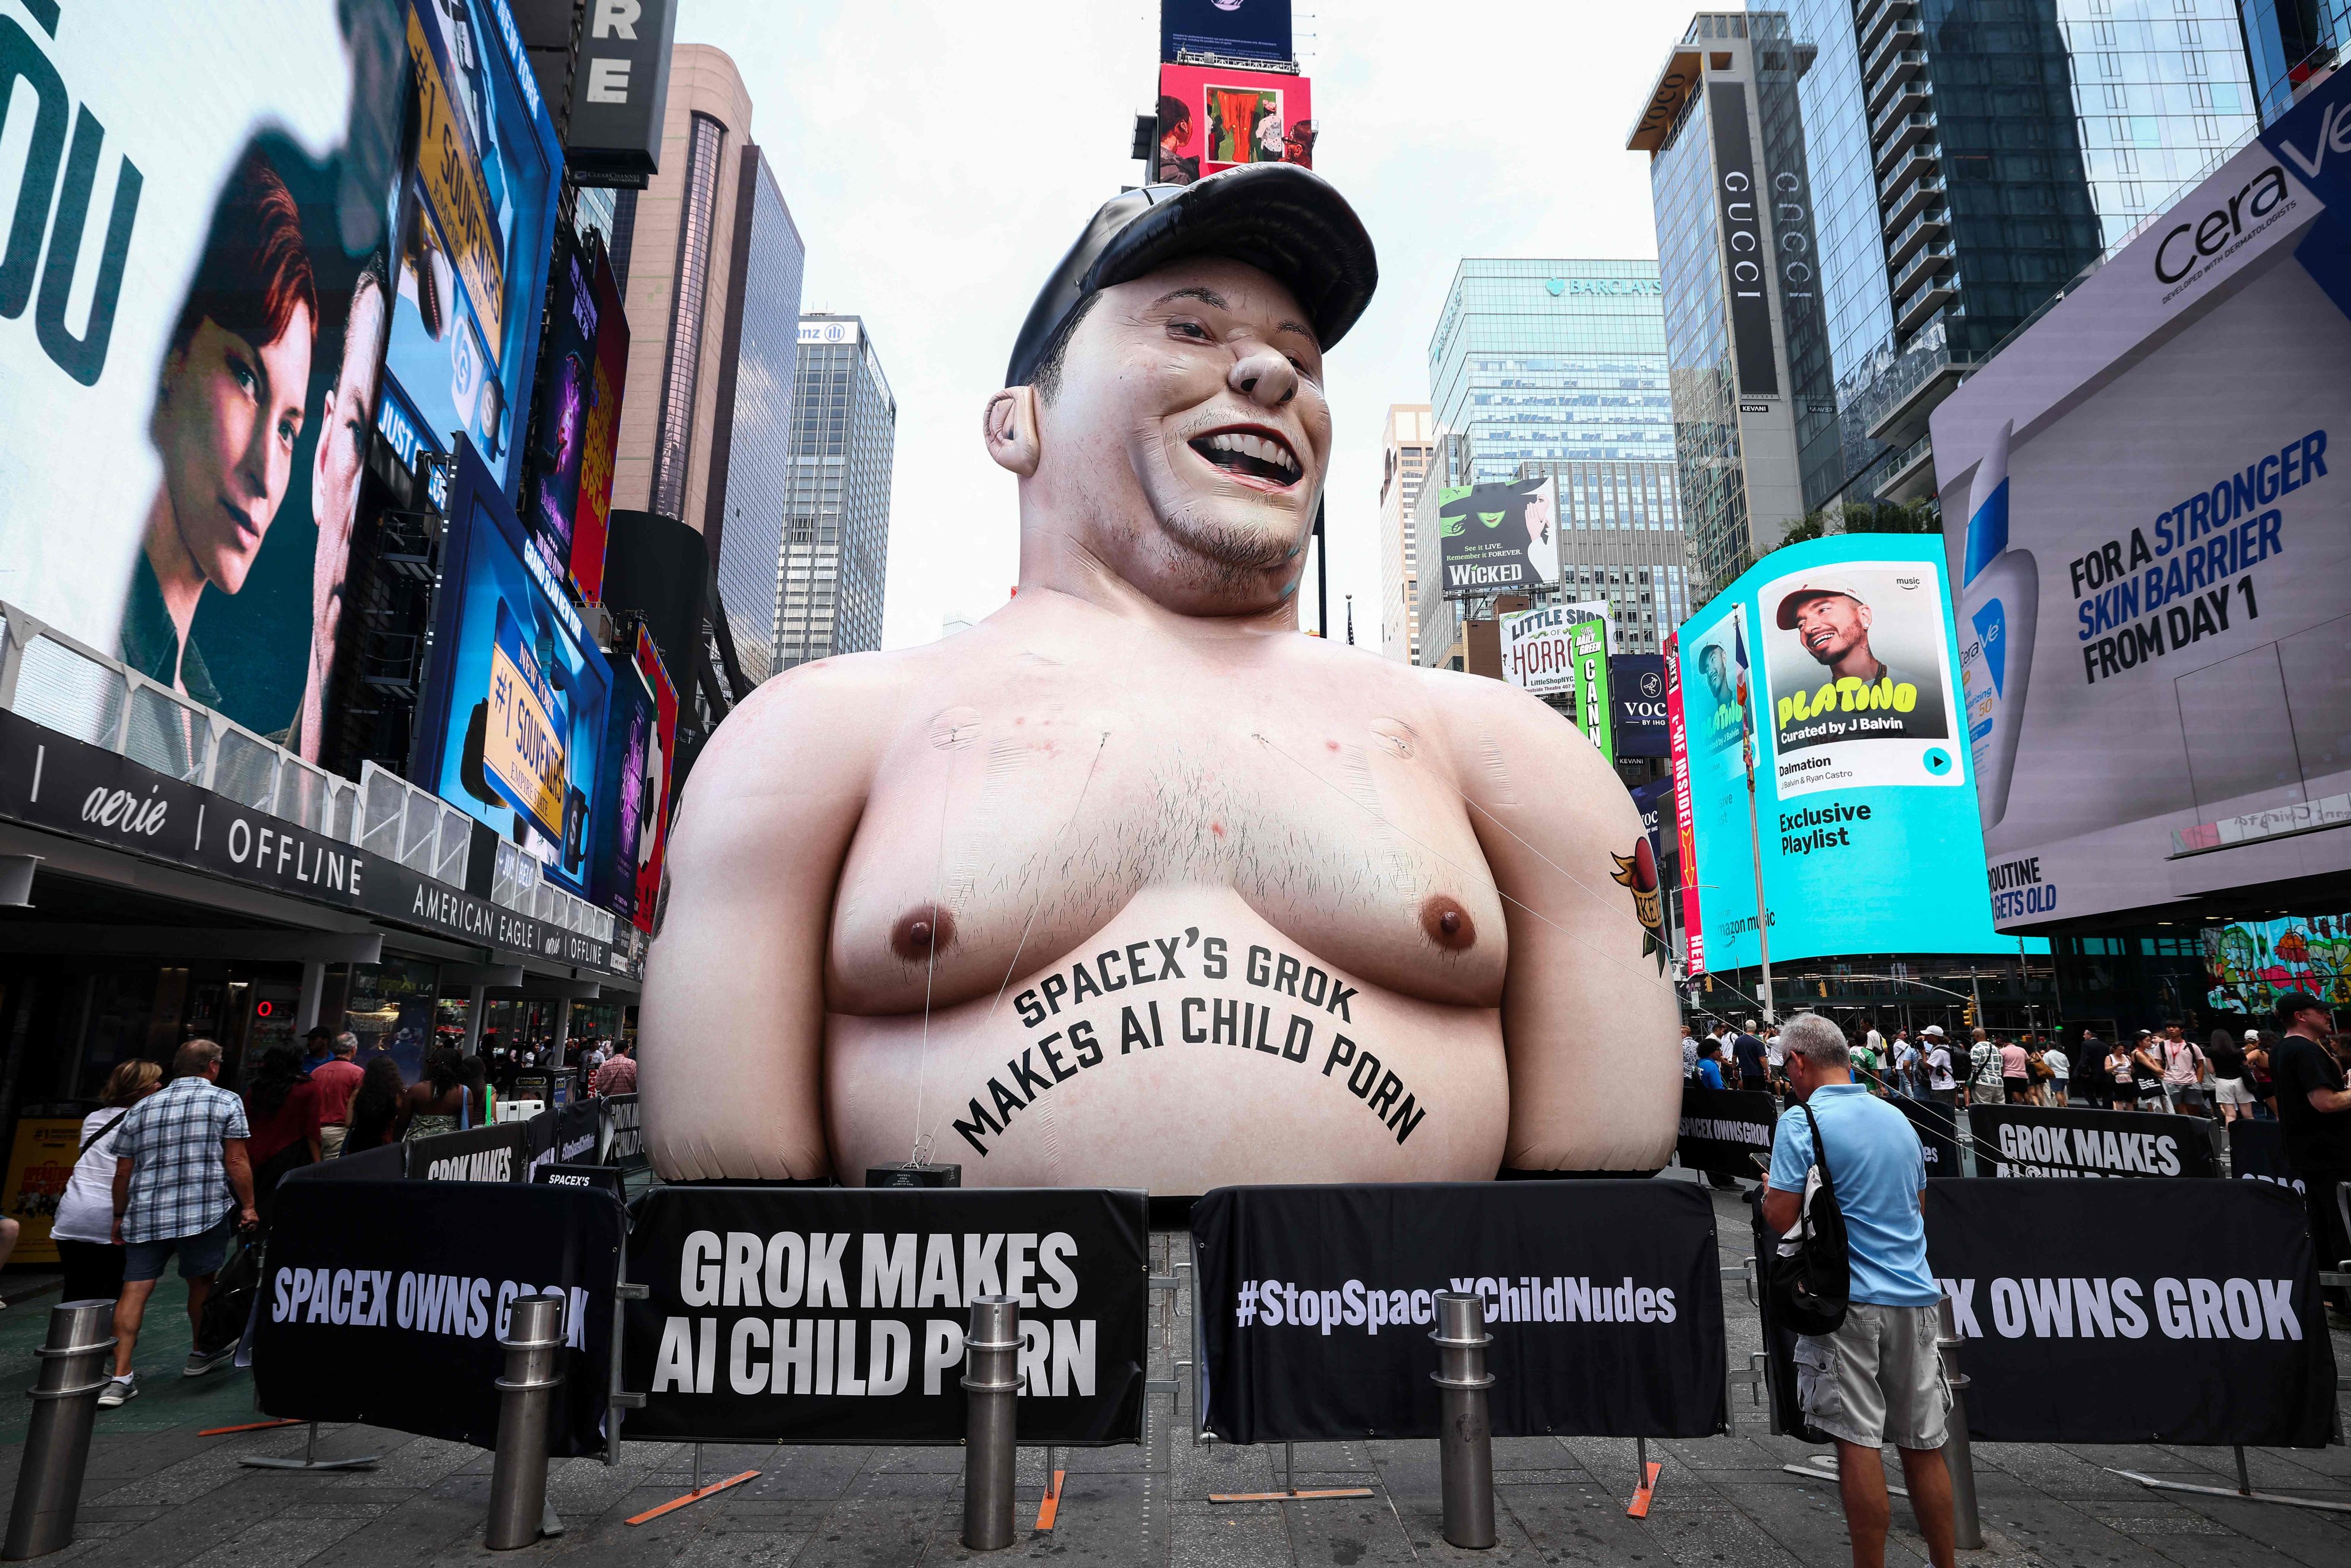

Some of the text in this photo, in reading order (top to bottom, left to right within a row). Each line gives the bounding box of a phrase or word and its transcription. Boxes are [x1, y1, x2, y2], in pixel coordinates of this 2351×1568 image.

[440, 123, 501, 324] SOUVENIRS
[1724, 171, 1761, 298] GUCCI
[2162, 200, 2297, 305] DEVELOPED WITH DERMATOLOGISTS
[1570, 279, 1662, 295] BARCLAYS
[378, 401, 414, 463] JUST
[2070, 429, 2329, 599] FOR A STRONGER
[1446, 553, 1480, 561] Remember
[1488, 549, 1522, 557] FOREVER.
[1896, 577, 1920, 585] music
[2078, 509, 2283, 641] SKIN BARRIER
[524, 539, 546, 585] GRAND
[544, 569, 559, 608] SLAM
[558, 591, 571, 624] NEW
[569, 608, 583, 643] YORK
[1512, 609, 1563, 642] LITTLE
[1576, 632, 1596, 647] DAILY
[1578, 641, 1602, 657] GREEN
[1580, 626, 1594, 635] The
[2083, 574, 2259, 685] FROM DAY 1
[519, 641, 554, 721] NEW YORK
[1778, 677, 1917, 731] PLATINO
[1978, 698, 1992, 717] 50
[495, 667, 564, 804] #1 SOUVENIRS
[1726, 727, 1740, 743] Balvin
[1781, 723, 1827, 744] Curated
[1828, 720, 1846, 735] by
[1848, 719, 1858, 732] J
[1859, 717, 1903, 731] Balvin
[510, 761, 549, 817] EMPIRE STATE
[1675, 756, 1691, 828] INSIDE!
[1779, 756, 1832, 777] Dalmation
[1784, 778, 1800, 789] Balvin
[1806, 774, 1824, 785] Ryan
[1825, 770, 1853, 780] Castro
[82, 784, 363, 895] aerie OFFLINE
[1780, 802, 1871, 833] Exclusive
[1782, 827, 1850, 856] Playlist
[413, 884, 494, 938] AMERICAN
[499, 915, 533, 949] EAGLE
[545, 932, 561, 956] aerie
[571, 938, 602, 965] OFFLINE
[1717, 916, 1746, 938] mazon
[1747, 907, 1776, 933] muic
[1995, 887, 2024, 921] GETS
[2027, 883, 2057, 915] OLD
[1013, 927, 1359, 1029] SPACEX'S GROK
[952, 996, 1427, 1158] MAKES AI CHILD PORN
[1679, 1115, 1771, 1147] SPACEX OWNS GROK
[1999, 1123, 2182, 1177] GROK MAKES
[470, 1146, 512, 1182] MAKES
[680, 1230, 1079, 1309] GROK MAKES
[271, 1267, 589, 1353] SPACEX OWNS GK
[1236, 1276, 1677, 1336] #StopSpacChildNudes
[1991, 1278, 2149, 1339] OWNS
[2153, 1277, 2303, 1340] GROK
[652, 1317, 1096, 1398] AI CHILD PRN
